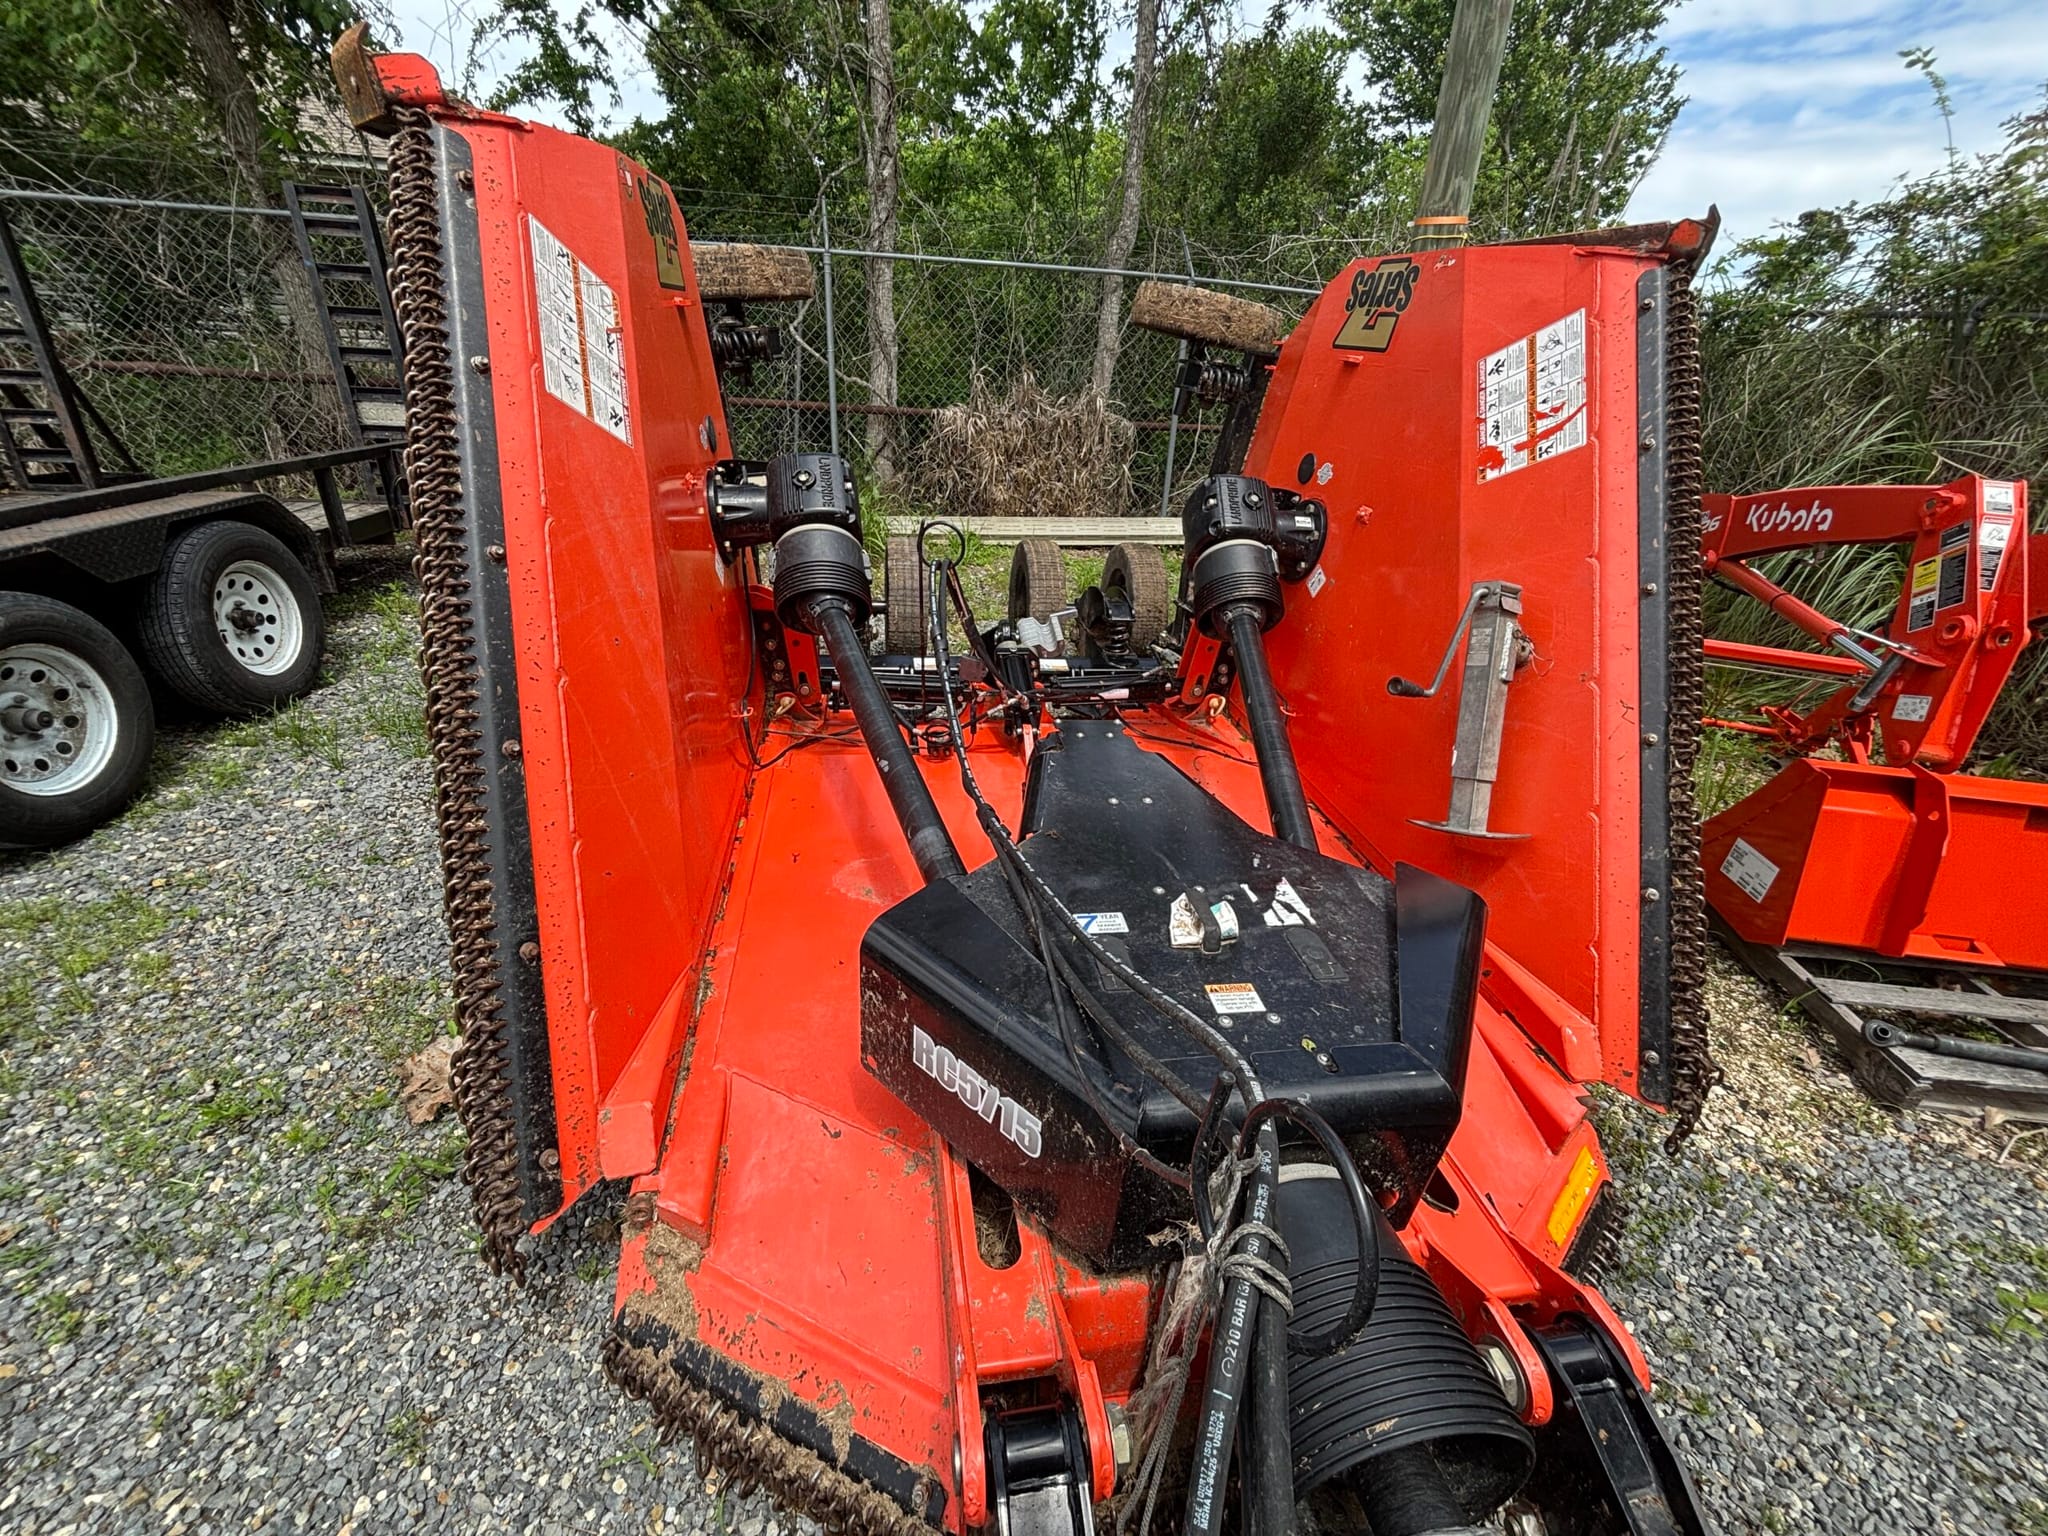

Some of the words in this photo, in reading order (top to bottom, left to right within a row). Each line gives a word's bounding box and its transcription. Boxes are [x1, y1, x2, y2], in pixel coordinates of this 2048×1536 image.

[1345, 265, 1420, 313] Series
[1745, 500, 1833, 532] Kubota
[1077, 914, 1098, 932] 7
[913, 1024, 1042, 1158] RC5715
[1231, 1296, 1247, 1327] BAR
[1225, 1328, 1241, 1358] 210
[1192, 1504, 1203, 1526] SAE
[1199, 1497, 1211, 1530] MSHA
